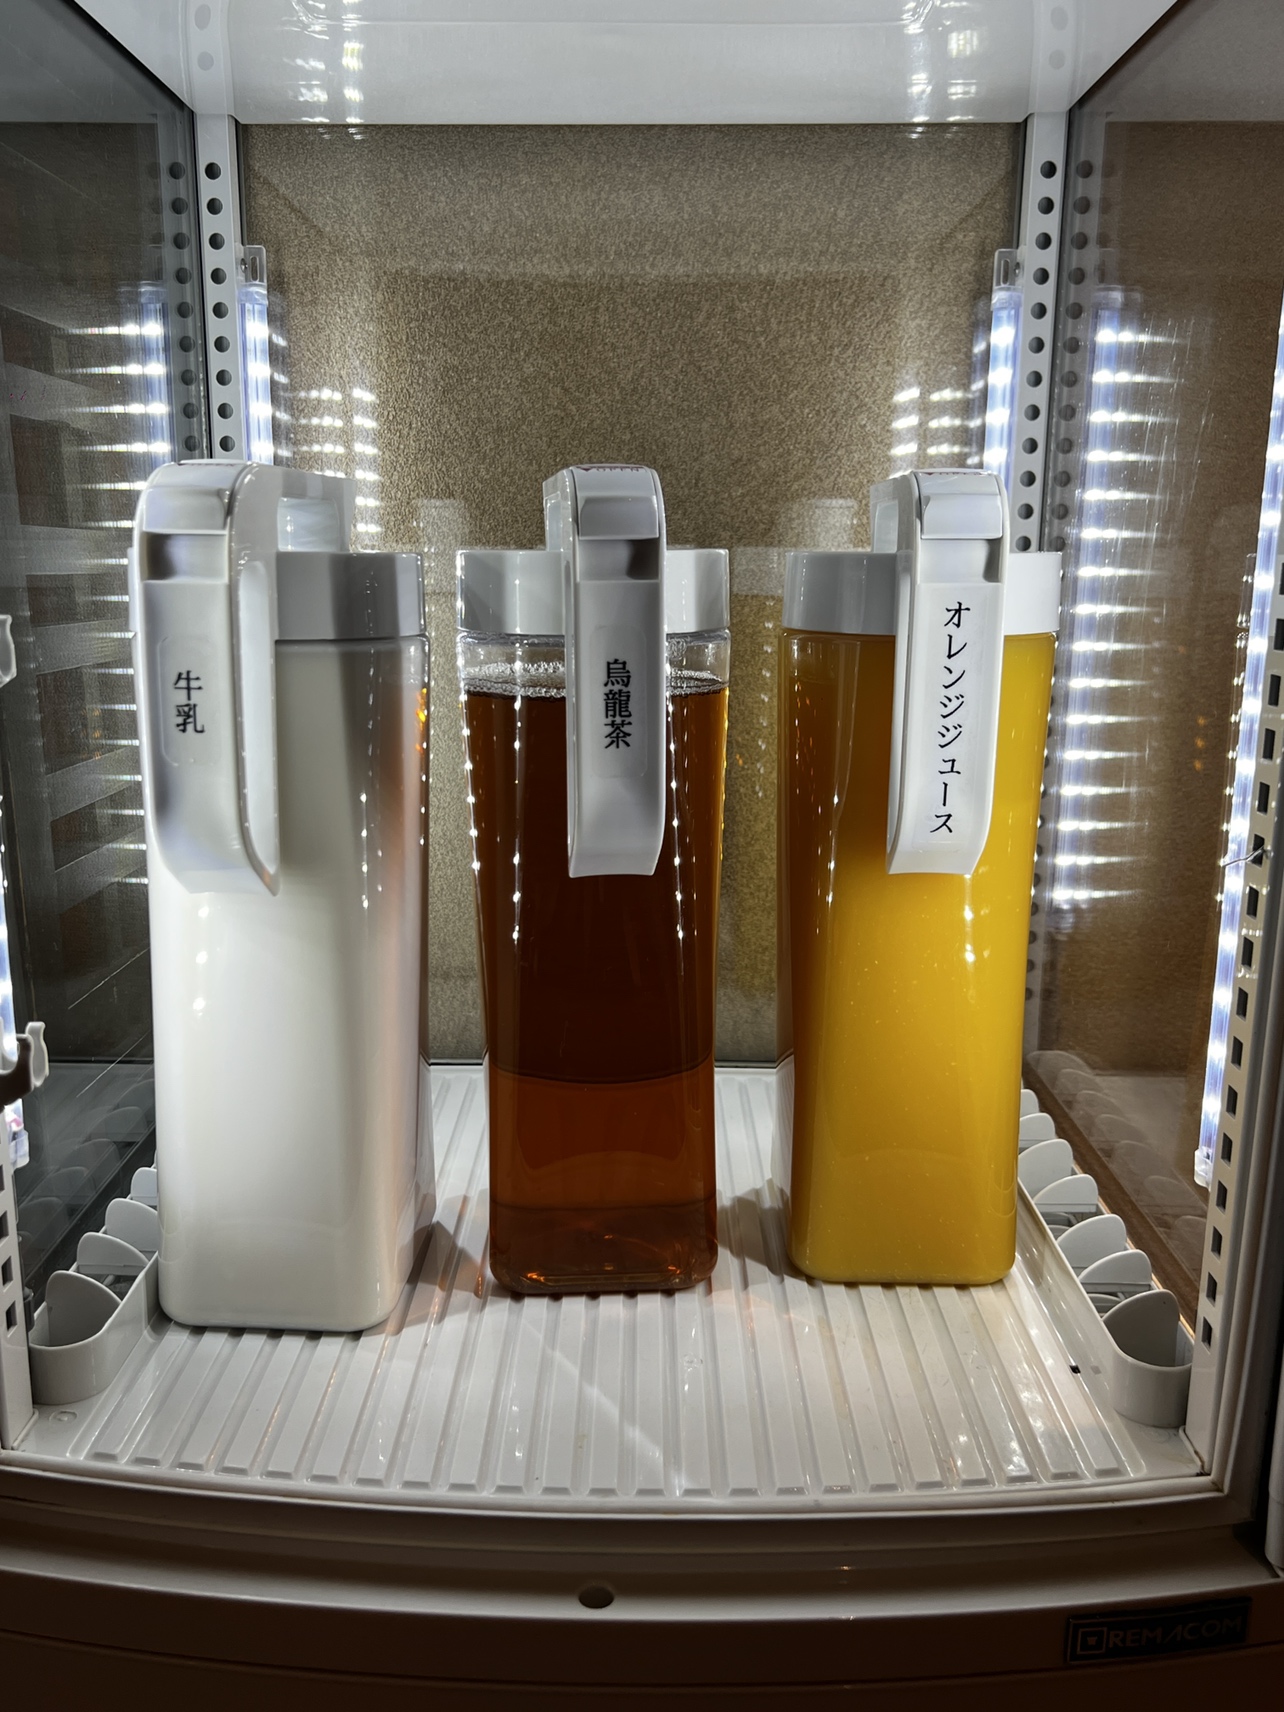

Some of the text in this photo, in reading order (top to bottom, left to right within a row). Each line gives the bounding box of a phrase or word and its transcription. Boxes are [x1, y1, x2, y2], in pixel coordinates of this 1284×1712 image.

[173, 670, 205, 734] 牛乳
[603, 658, 633, 749] 烏龍茶
[930, 601, 971, 834] オレンジジュース
[1108, 1615, 1243, 1648] REMACOM
